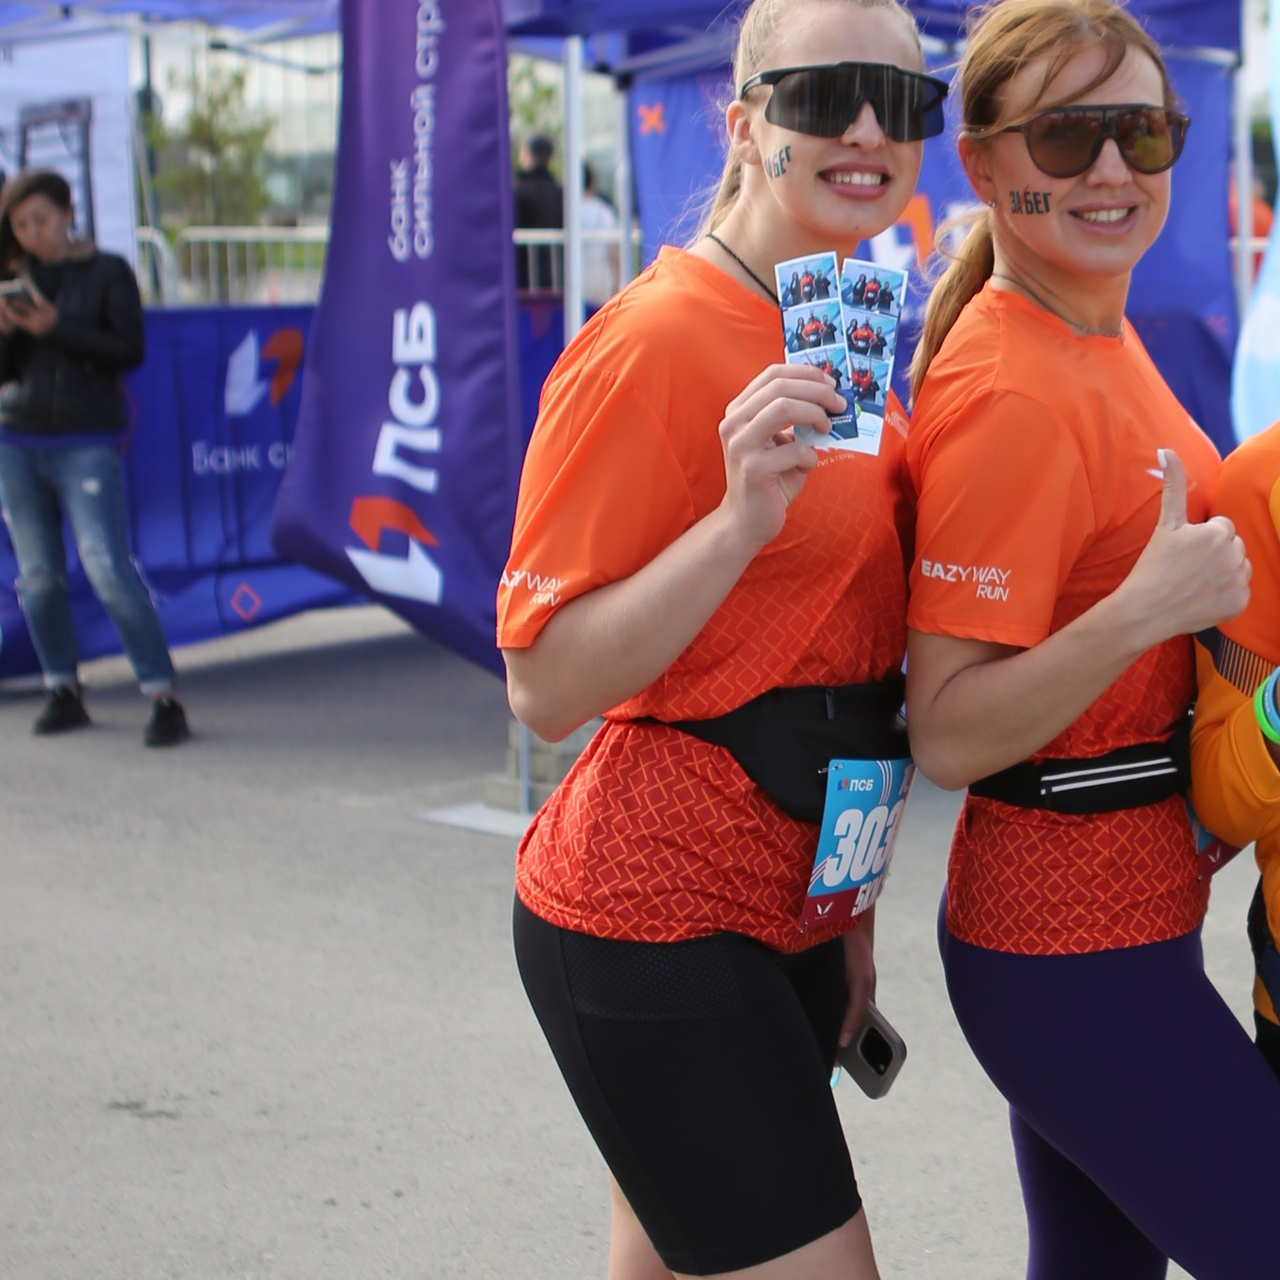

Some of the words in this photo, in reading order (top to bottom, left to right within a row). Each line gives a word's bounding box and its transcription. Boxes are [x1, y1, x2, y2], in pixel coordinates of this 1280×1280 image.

[389, 158, 409, 262] банк
[410, 84, 434, 259] сильной
[373, 301, 440, 492] ПСБ
[976, 584, 1009, 602] RUN
[849, 778, 874, 792] ПСБ
